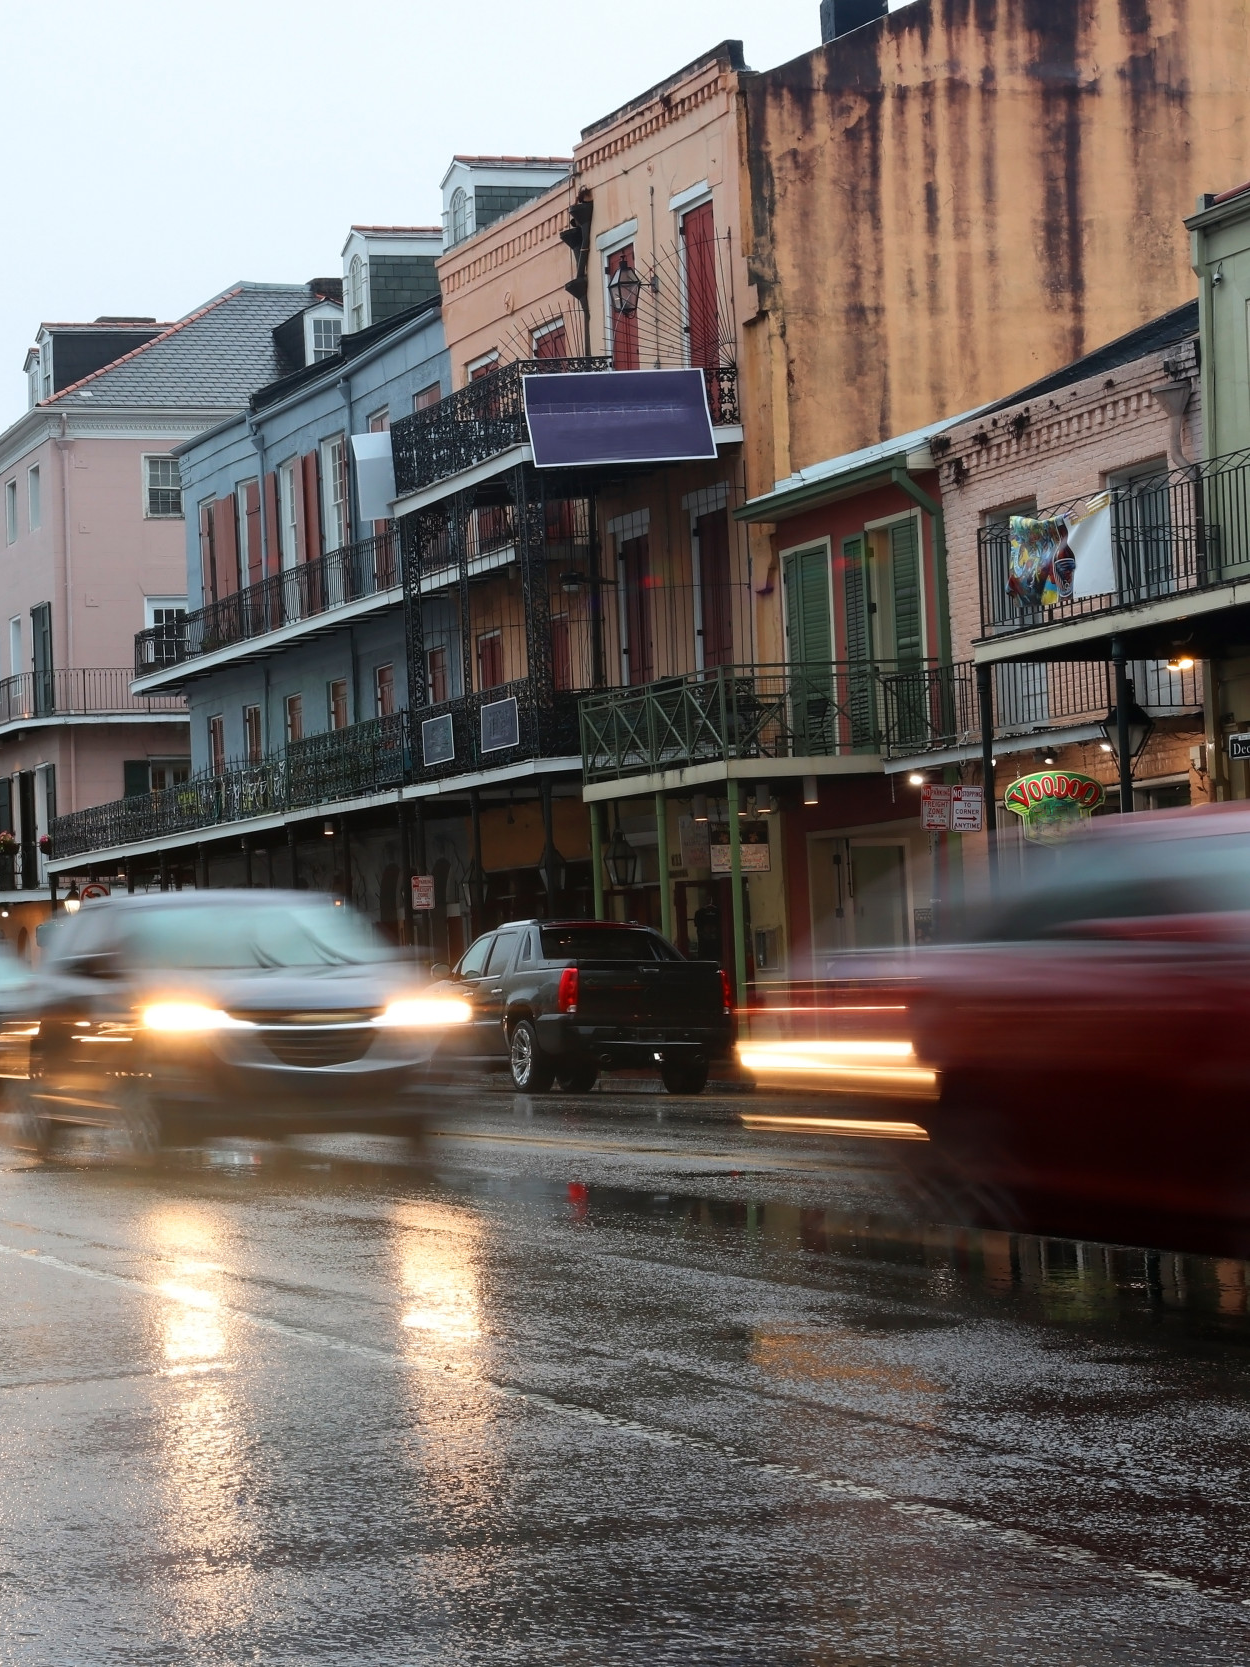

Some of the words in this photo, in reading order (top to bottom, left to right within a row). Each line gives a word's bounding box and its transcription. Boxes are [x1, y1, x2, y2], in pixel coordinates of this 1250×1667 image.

[922, 788, 931, 798] NO
[953, 789, 962, 798] NO
[1008, 775, 1100, 807] VOODOO
